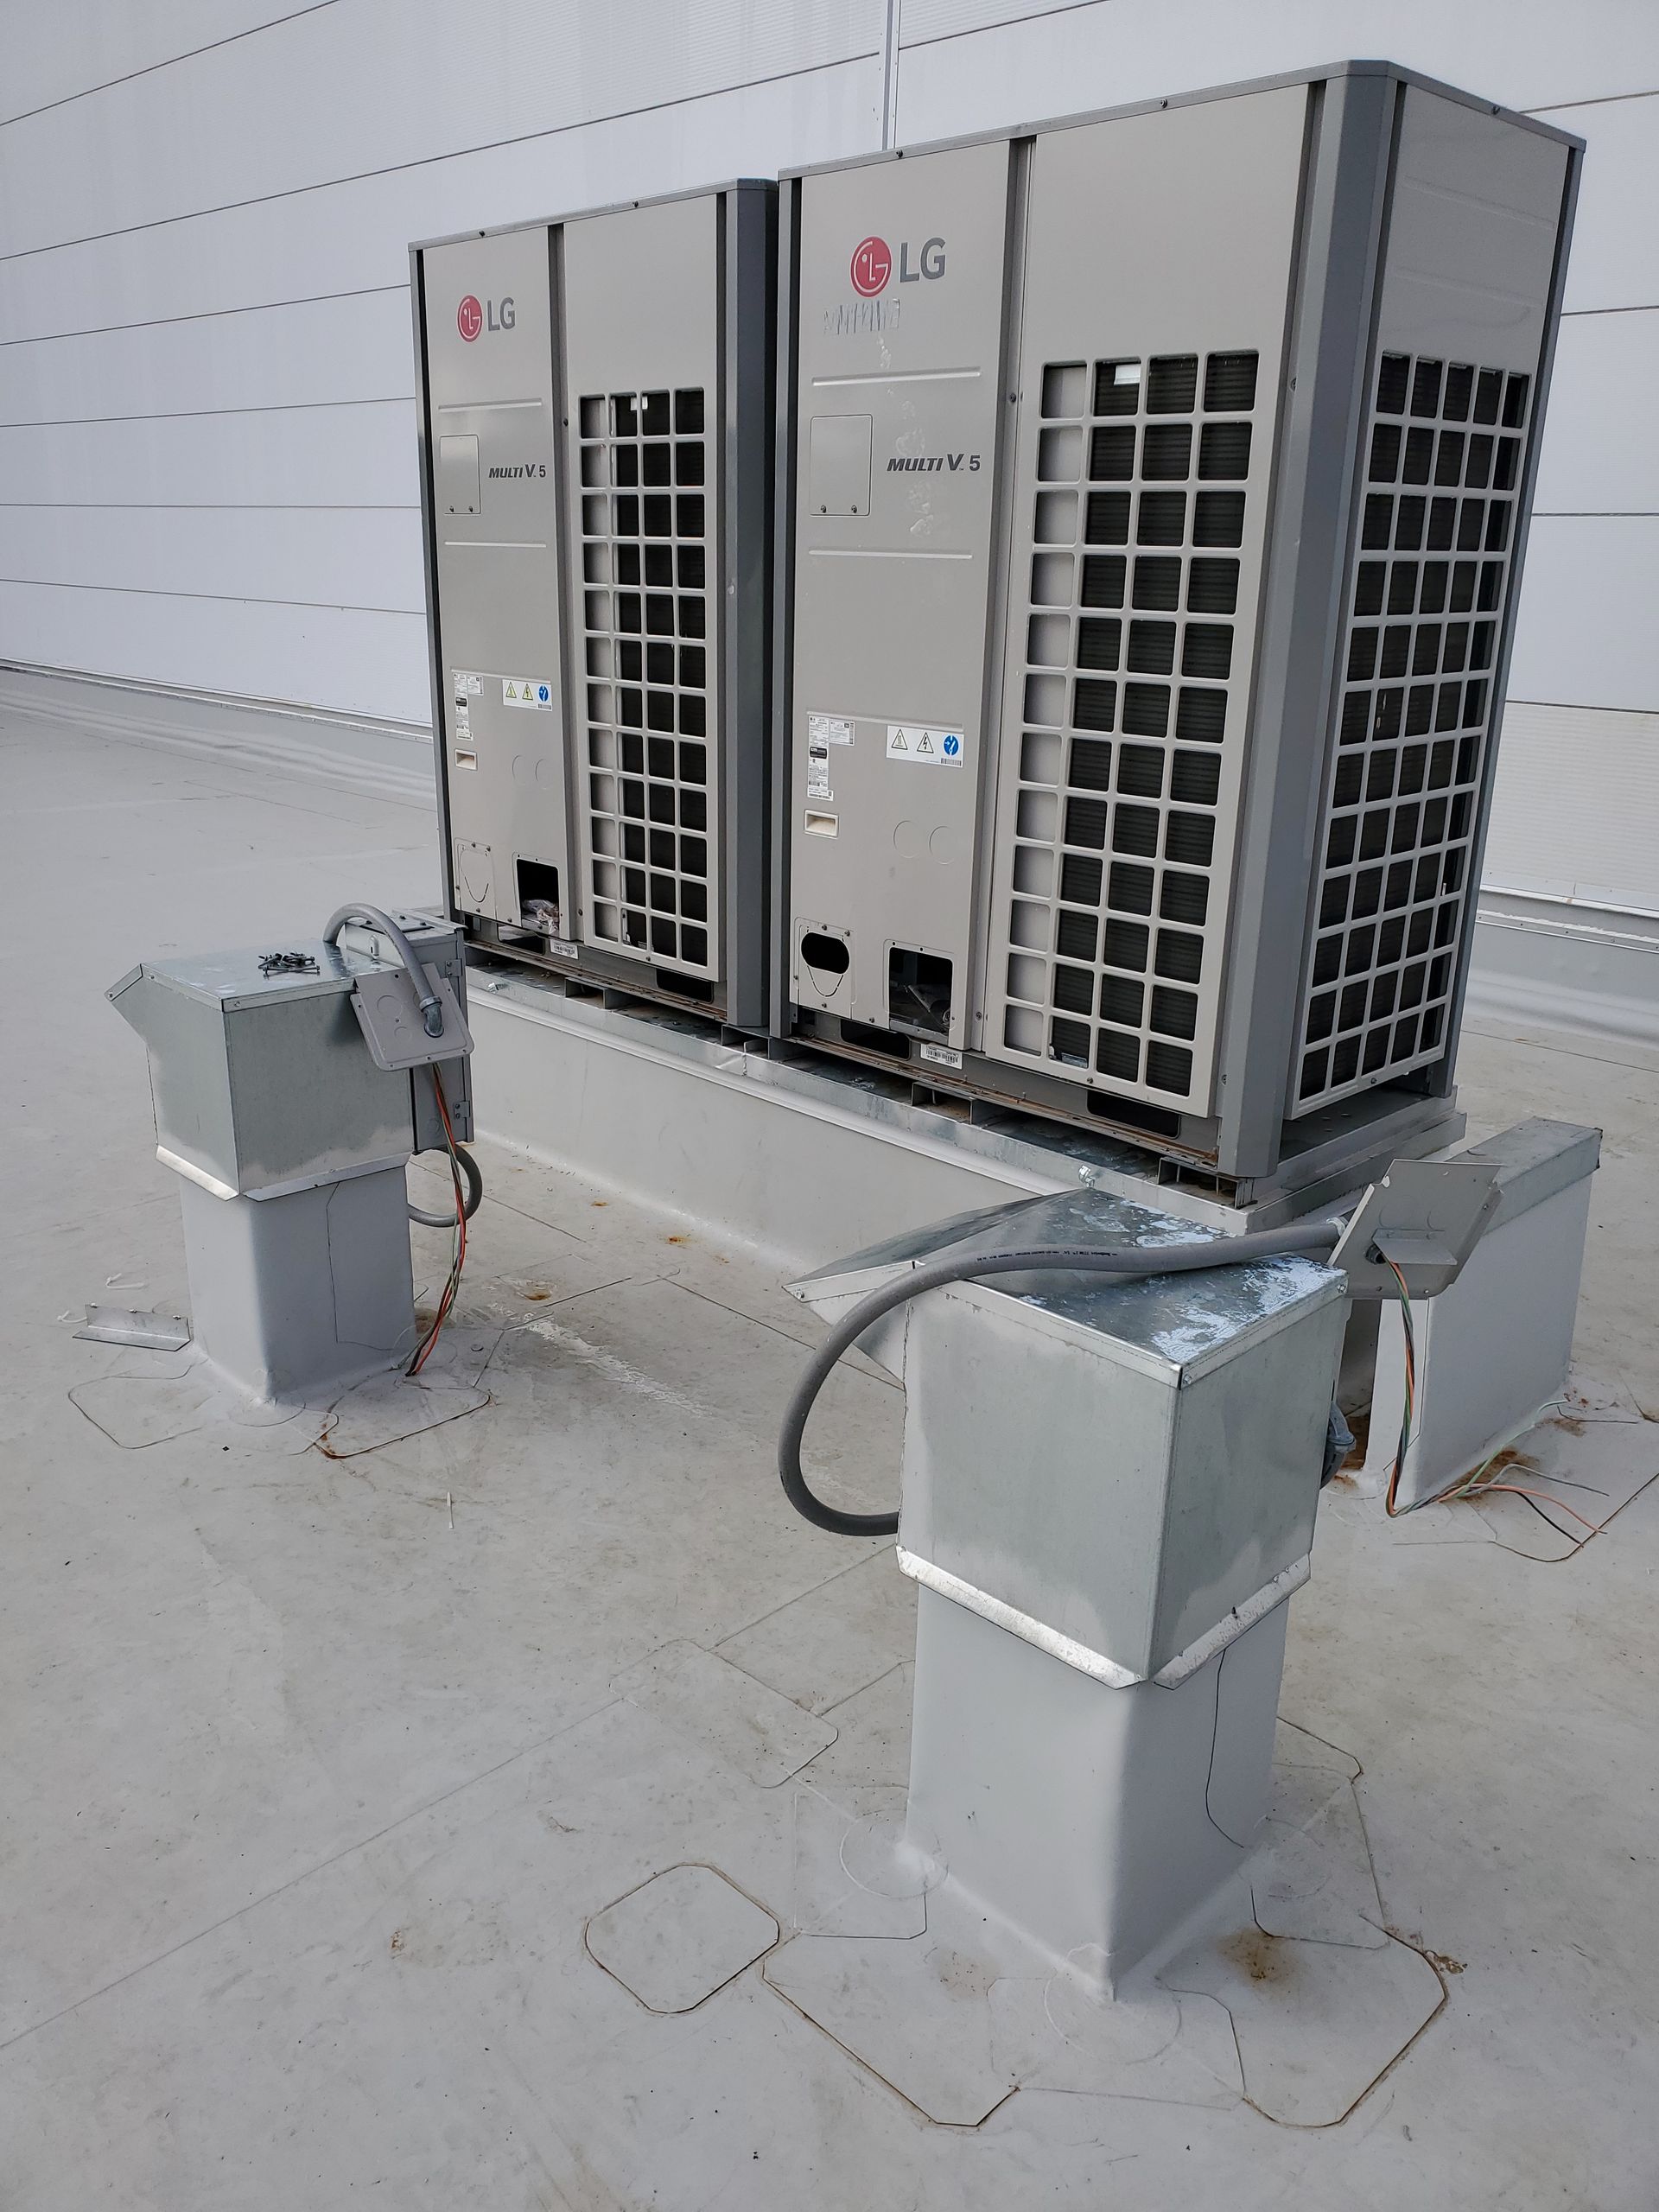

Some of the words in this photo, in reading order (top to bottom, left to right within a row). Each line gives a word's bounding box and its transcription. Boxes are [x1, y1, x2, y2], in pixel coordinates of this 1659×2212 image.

[899, 237, 946, 283] LG
[487, 297, 516, 332] LG
[488, 467, 524, 479] MULTI
[538, 464, 546, 478] 5
[887, 457, 944, 472] MULTI
[969, 454, 981, 472] 5
